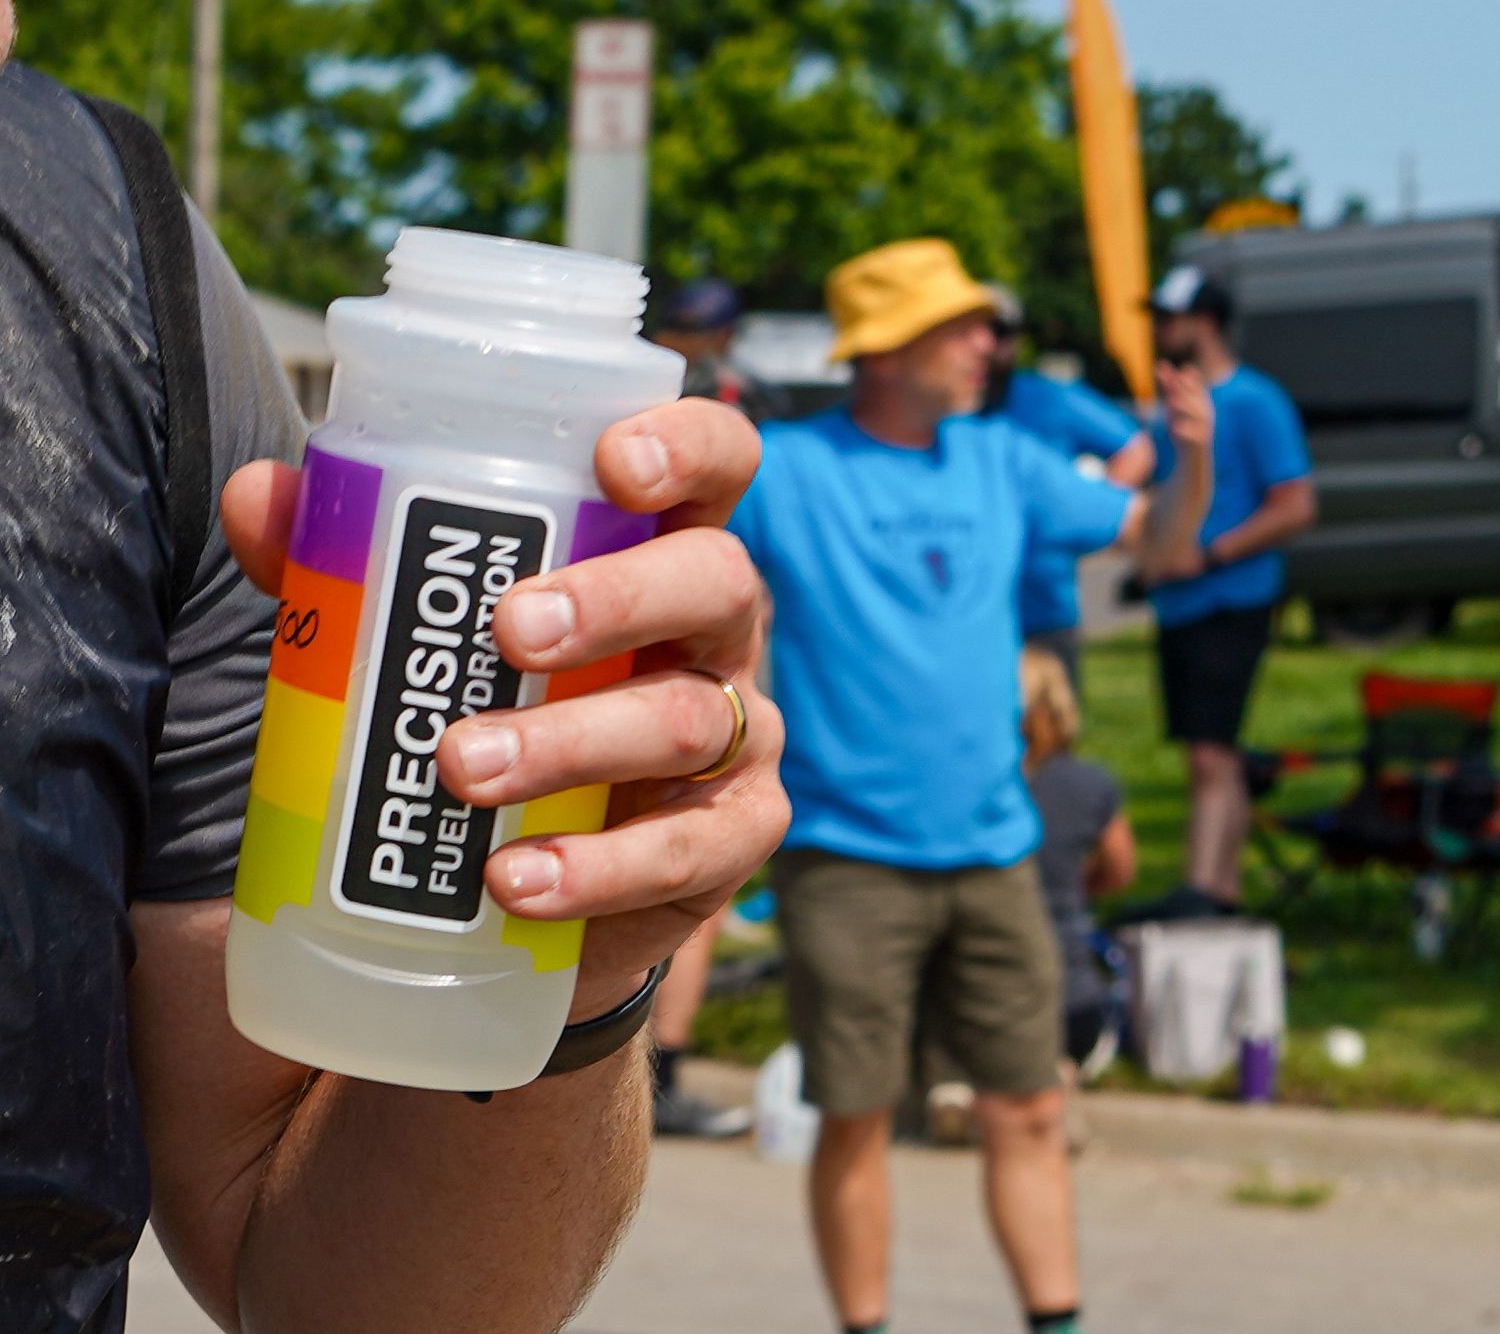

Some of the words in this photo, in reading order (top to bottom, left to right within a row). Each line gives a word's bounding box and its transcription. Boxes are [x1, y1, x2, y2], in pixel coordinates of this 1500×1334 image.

[369, 524, 481, 889] PRECISION
[427, 803, 472, 896] FUEL
[459, 534, 522, 716] DRATION
